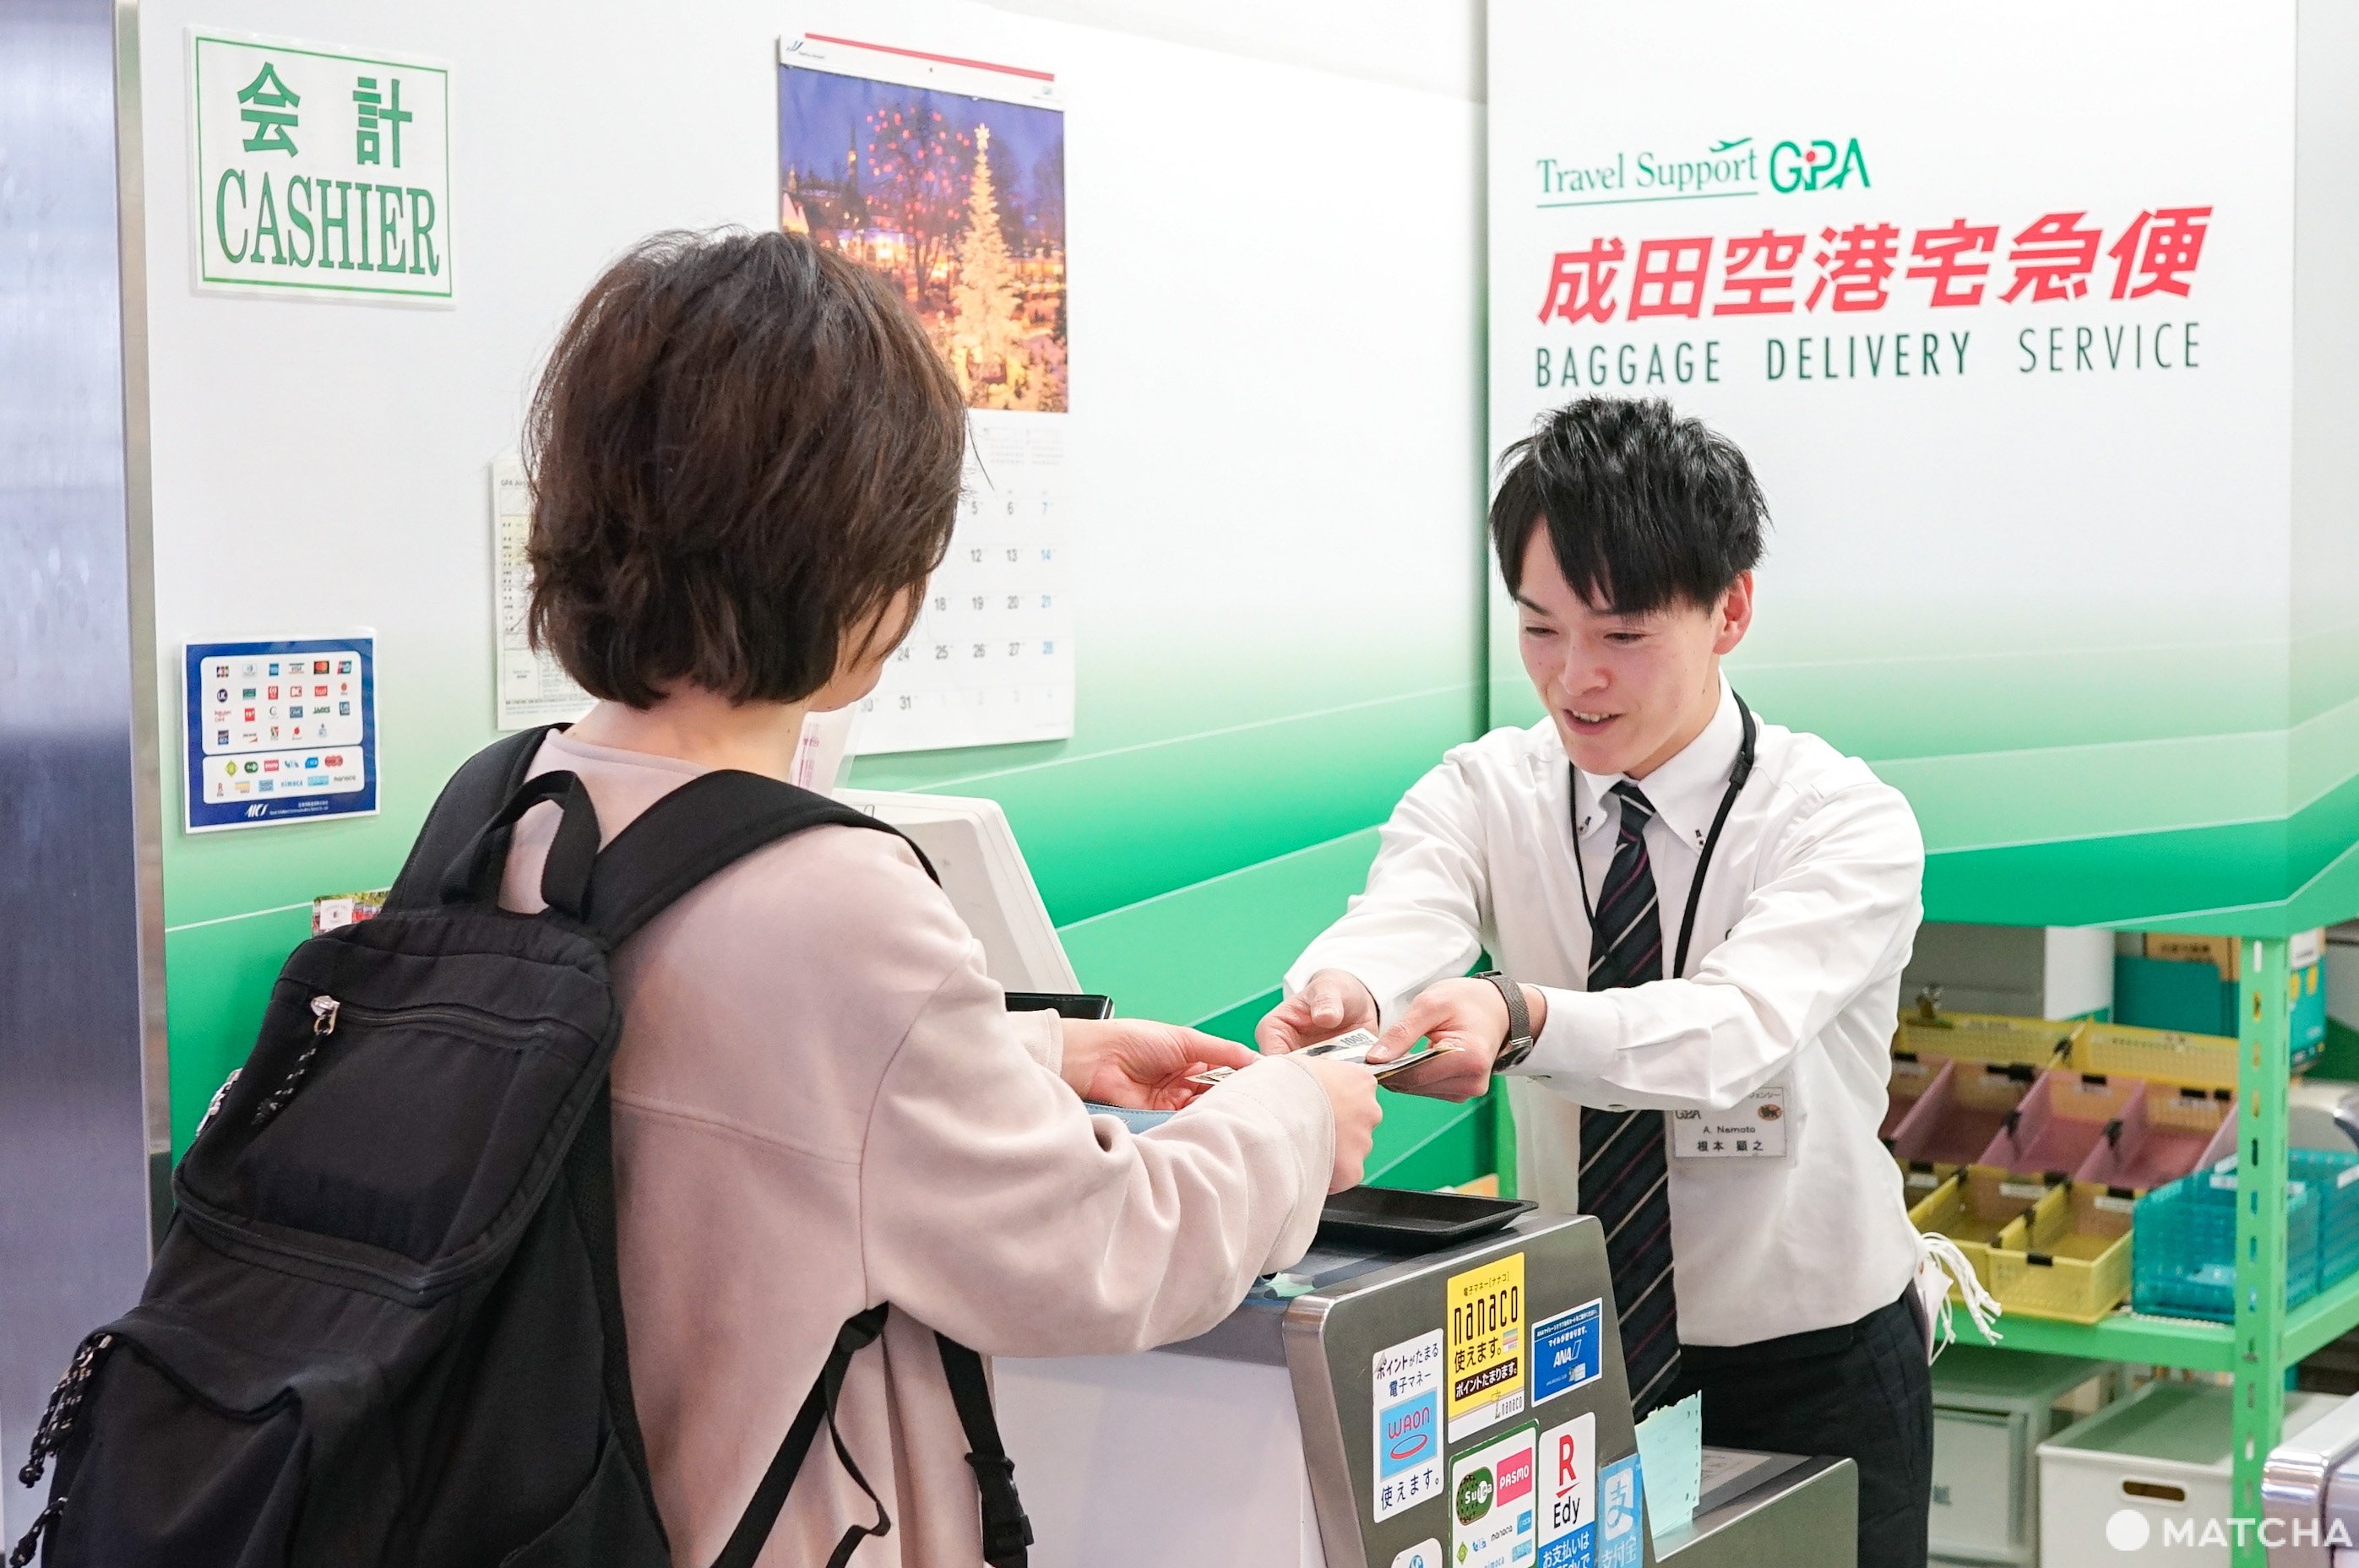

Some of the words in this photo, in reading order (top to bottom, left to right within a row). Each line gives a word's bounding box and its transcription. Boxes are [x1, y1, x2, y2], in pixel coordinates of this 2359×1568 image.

[237, 61, 413, 168] 会計
[1537, 153, 1625, 193] Travel
[1635, 148, 1758, 192] Support
[1769, 138, 1871, 193] GPA
[216, 168, 439, 277] CASHIER
[1537, 204, 2214, 326] 成田空港宅急便
[1536, 341, 1720, 388] BAGGAGE
[1767, 331, 1970, 380] DELIVERY
[2019, 322, 2200, 373] SERVICE
[1007, 502, 1014, 515] 6
[970, 549, 981, 562] 12
[1007, 549, 1018, 562] 13
[934, 596, 946, 611] 18
[972, 595, 984, 610] 19
[1007, 595, 1019, 610] 20
[1041, 594, 1052, 608] 21
[897, 647, 910, 661] 24
[935, 644, 948, 659] 25
[973, 643, 986, 658] 26
[1008, 642, 1020, 656] 27
[900, 695, 911, 710] 31
[1340, 1033, 1370, 1047] 1000
[1717, 1125, 1756, 1134] Nemoto
[1454, 1285, 1518, 1346] nanaco
[1377, 1343, 1439, 1380] ポイントがたまる
[1454, 1337, 1502, 1374] 使えます。
[1553, 1346, 1573, 1368] ANA
[1389, 1370, 1432, 1397] 電子マネー
[1455, 1361, 1517, 1398] ポイントたまります。
[1501, 1396, 1523, 1416] nanaco
[1499, 1465, 1530, 1490] PASMO
[1559, 1434, 1577, 1487] R
[1381, 1468, 1439, 1511] 使えます。
[1465, 1483, 1492, 1505] Suica
[1553, 1495, 1580, 1529] Edy
[1543, 1531, 1590, 1568] お支払いは
